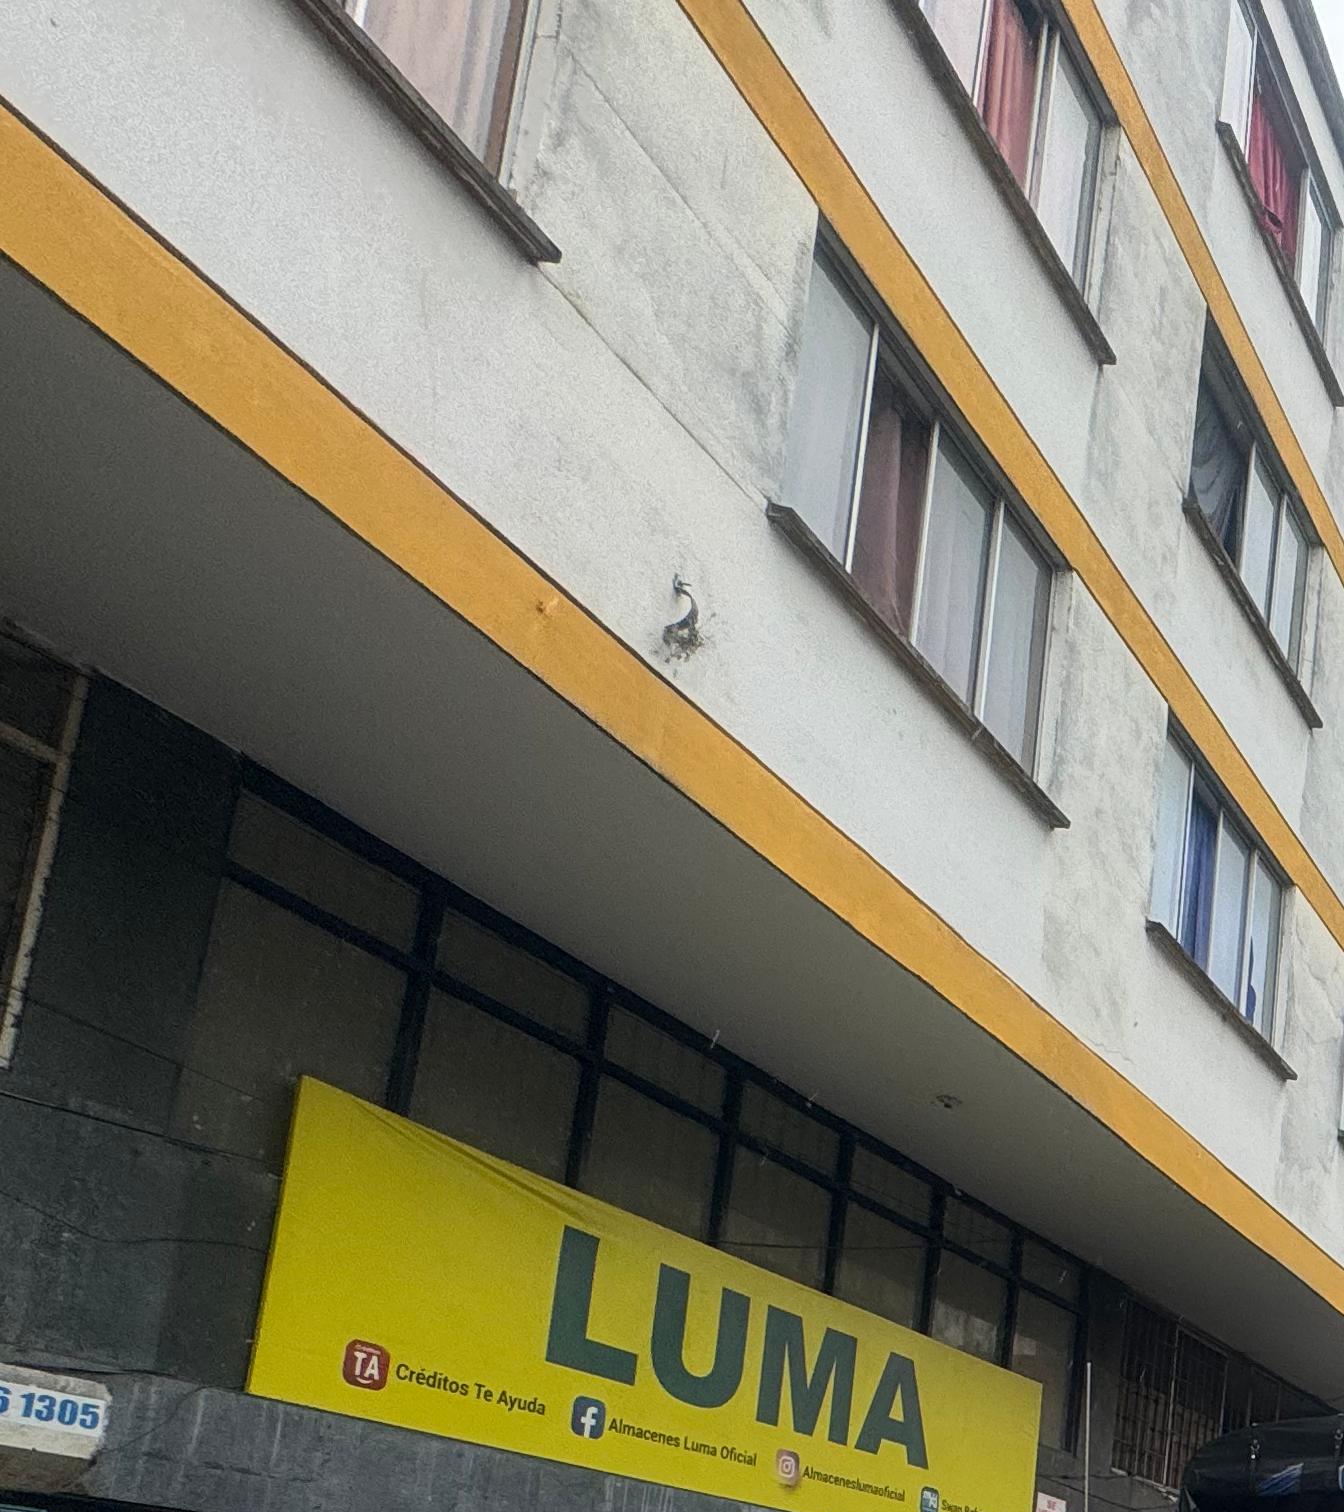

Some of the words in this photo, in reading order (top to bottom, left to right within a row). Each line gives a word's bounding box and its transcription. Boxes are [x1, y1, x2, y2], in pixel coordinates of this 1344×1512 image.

[354, 1351, 380, 1380] TA
[544, 1225, 929, 1470] LUMA
[20, 1392, 100, 1430] 1305
[396, 1363, 470, 1397] Créditos
[474, 1383, 494, 1402] Te
[496, 1390, 546, 1416] Ayuda
[608, 1418, 680, 1448] Almacenes
[684, 1436, 717, 1457] Luma
[720, 1446, 757, 1466] Oficial
[802, 1465, 906, 1503] Almaceneslumaoficial
